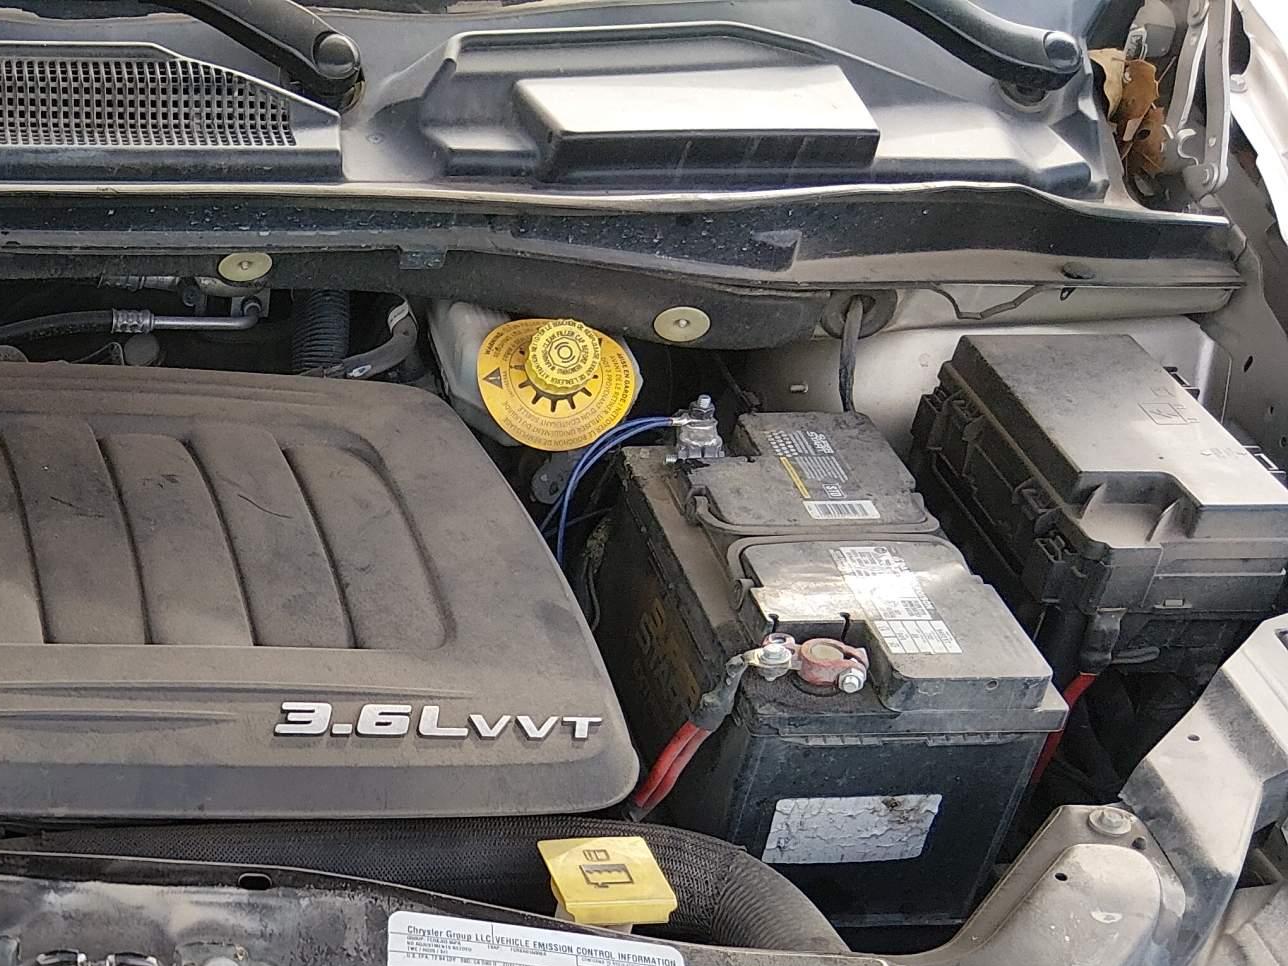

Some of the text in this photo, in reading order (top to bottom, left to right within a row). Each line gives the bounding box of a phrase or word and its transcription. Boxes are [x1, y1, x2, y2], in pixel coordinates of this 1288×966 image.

[407, 925, 444, 937] Chrysler
[446, 929, 472, 942] Group
[475, 933, 491, 943] LLC
[495, 935, 530, 948] VEHICLE
[533, 940, 574, 954] EMISSION
[576, 946, 616, 960] CONTROL
